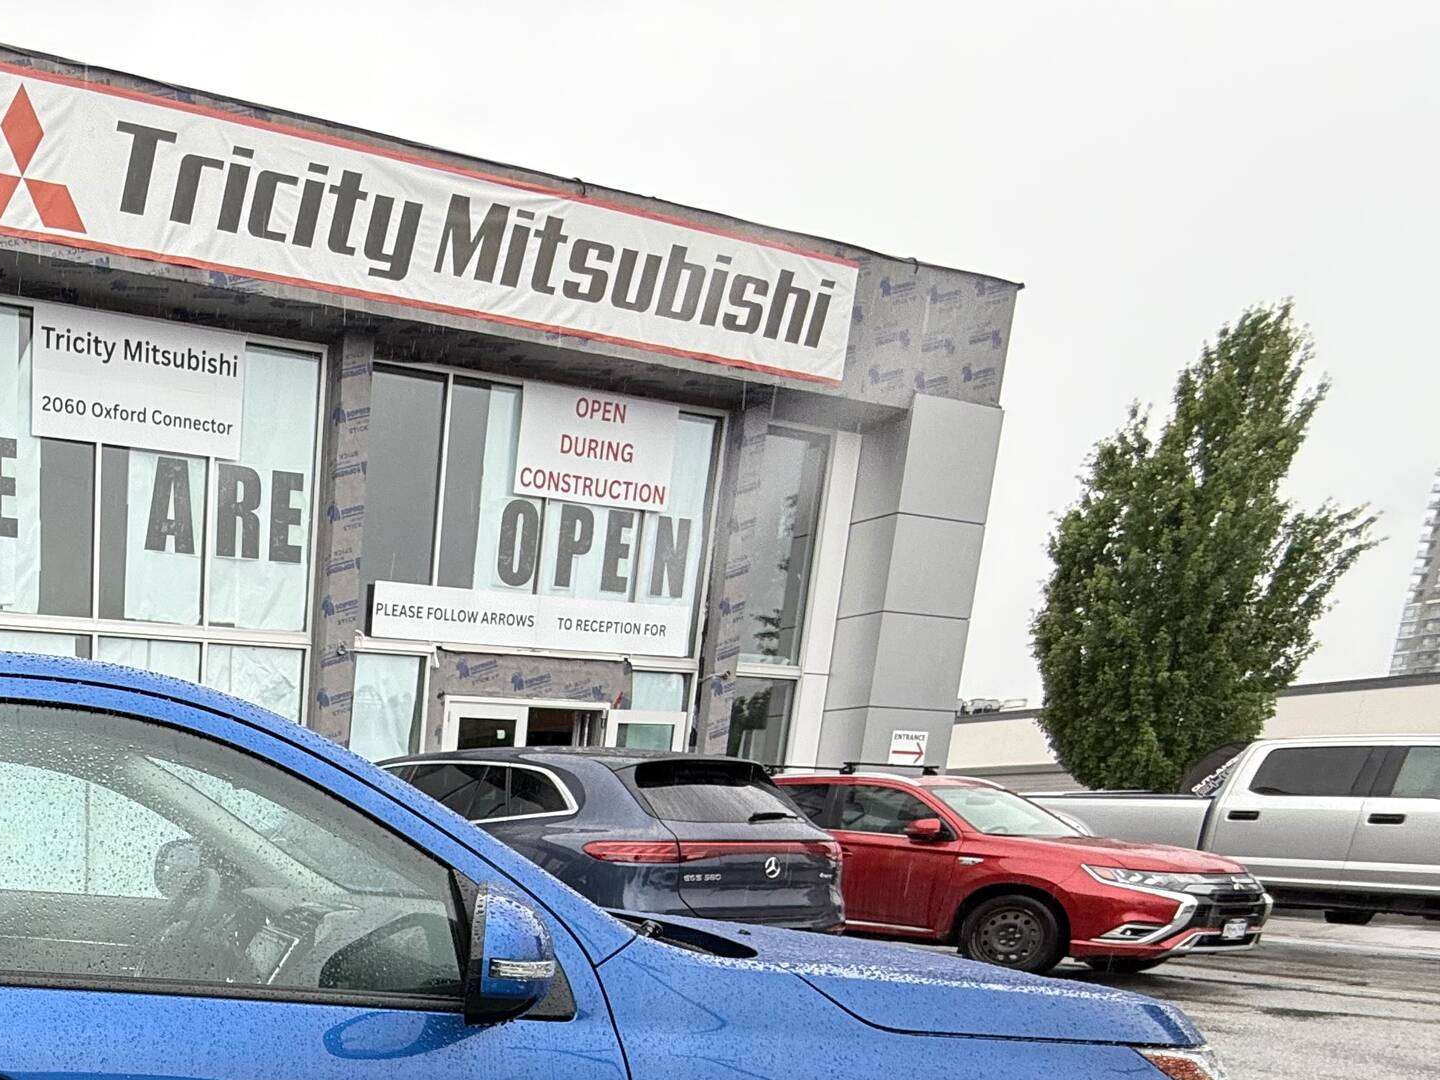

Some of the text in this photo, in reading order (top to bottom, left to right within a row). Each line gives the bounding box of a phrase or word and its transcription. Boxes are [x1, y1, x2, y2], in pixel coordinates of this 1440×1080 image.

[116, 120, 837, 348] Tricity Mitsubishi
[41, 325, 238, 377] Tricity Mitsubishi
[42, 395, 234, 435] 2060 Oxford Connector
[575, 397, 627, 424] OPEN
[560, 434, 634, 463] DURING
[520, 467, 666, 505] CONSTRUCTION
[144, 456, 305, 564] ARE
[497, 499, 692, 599] OPEN
[375, 602, 535, 628] PLEASE FOLLOW ARROWS
[557, 617, 667, 637] TO RECEPTION FOR
[894, 733, 926, 741] ENTRANCE
